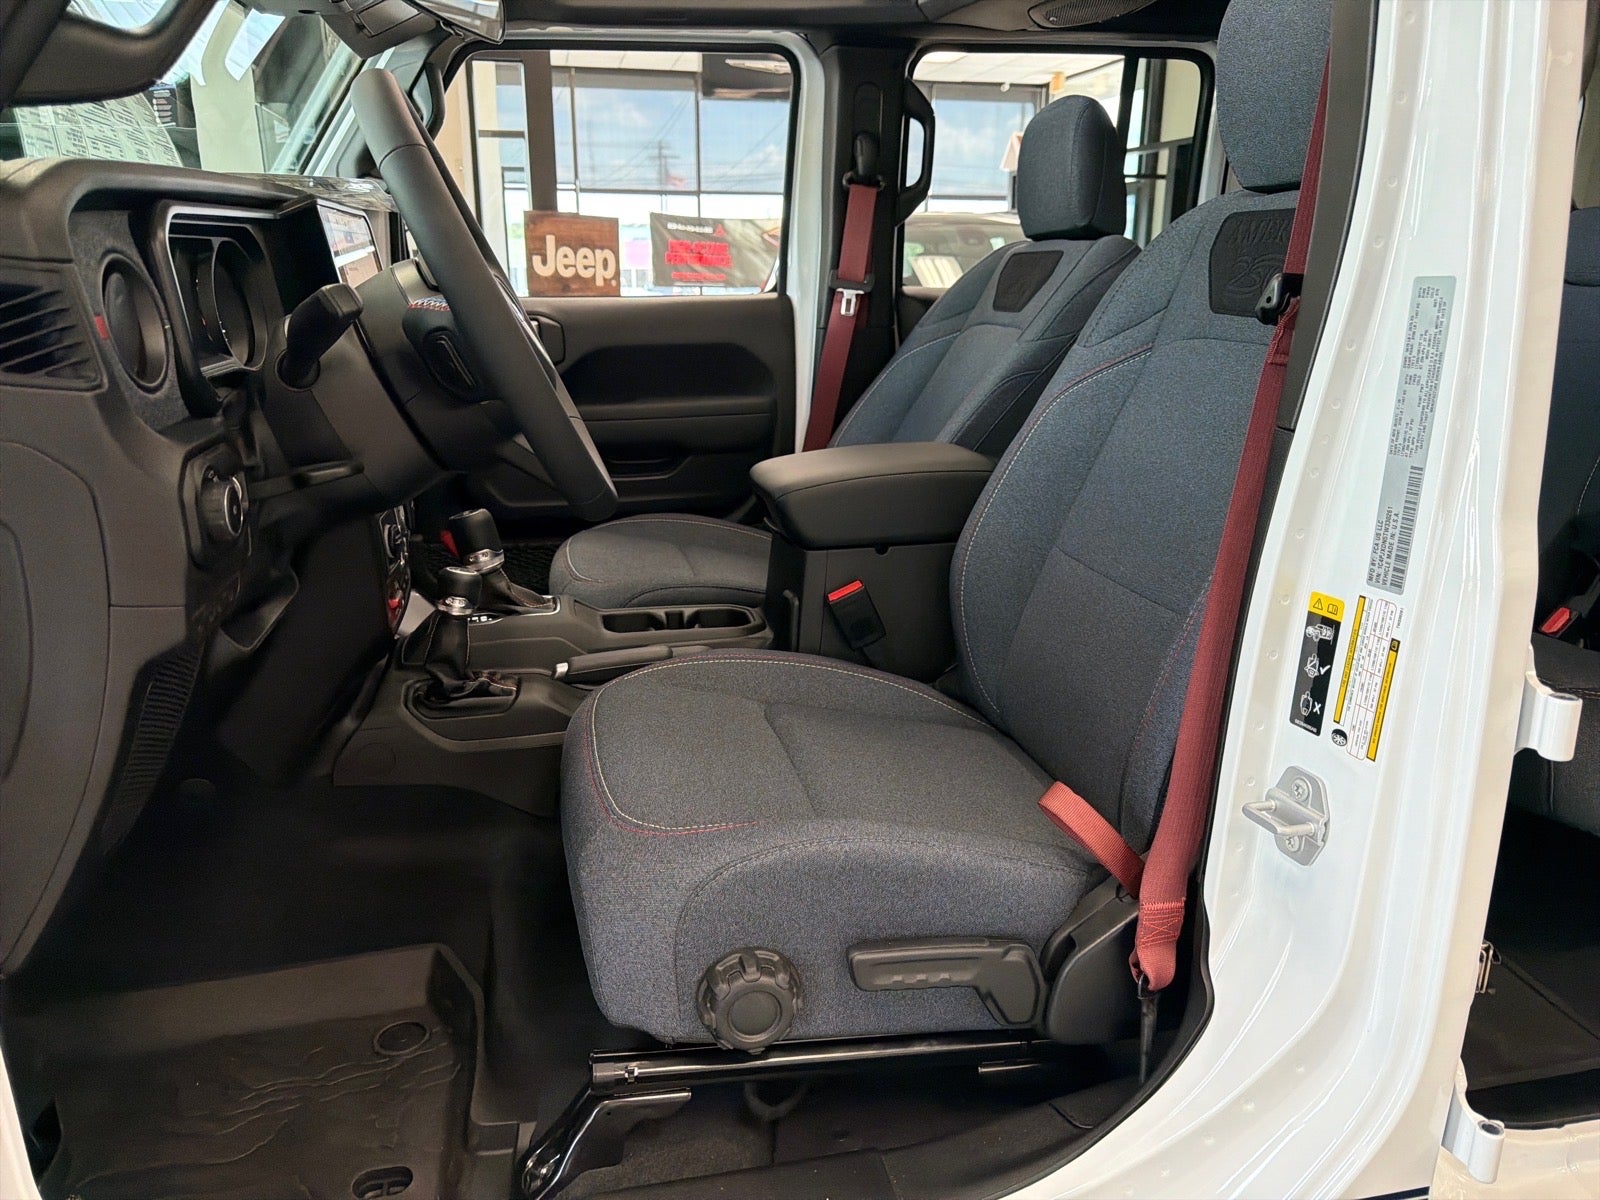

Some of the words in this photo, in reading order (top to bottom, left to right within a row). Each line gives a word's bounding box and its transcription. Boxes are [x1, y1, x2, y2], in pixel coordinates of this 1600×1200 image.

[532, 234, 616, 286] Jeep
[1375, 532, 1381, 540] US
[1381, 562, 1391, 586] VEHICLE
[1386, 542, 1394, 559] MADE
